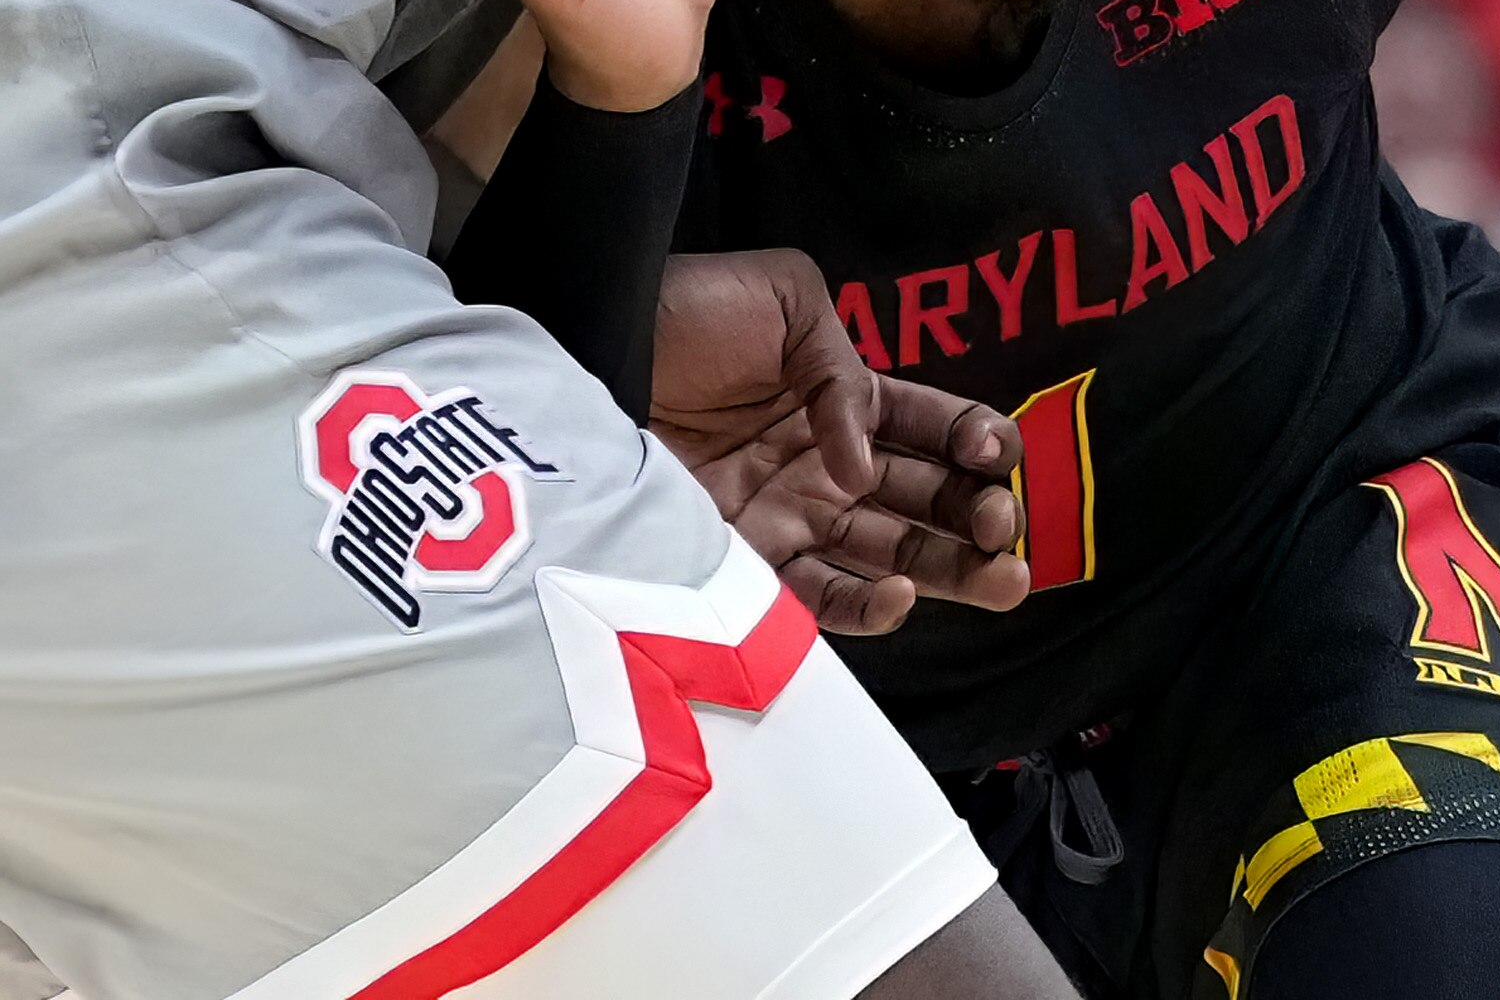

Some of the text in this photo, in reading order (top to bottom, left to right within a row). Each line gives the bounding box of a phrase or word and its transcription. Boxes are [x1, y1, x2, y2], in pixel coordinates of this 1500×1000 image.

[836, 93, 1305, 370] ARYLAND
[331, 396, 560, 628] OHIO STATE
[1009, 368, 1098, 593] 1
